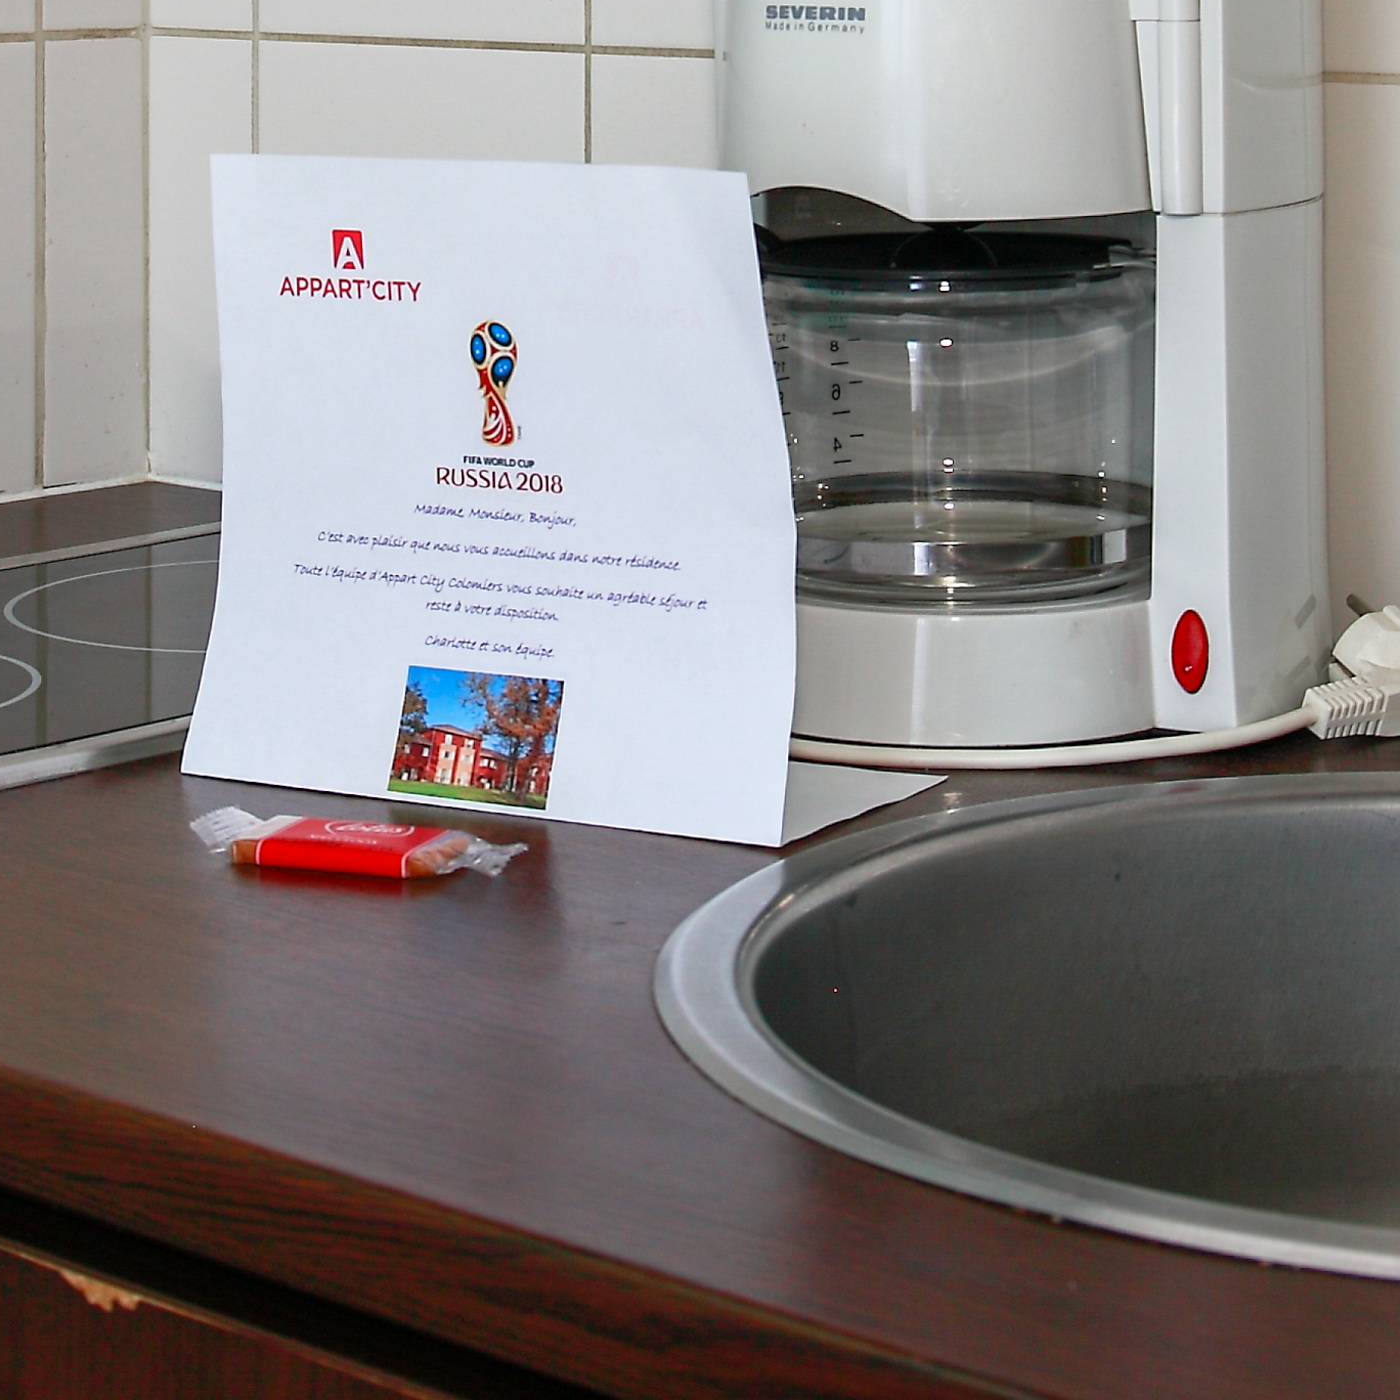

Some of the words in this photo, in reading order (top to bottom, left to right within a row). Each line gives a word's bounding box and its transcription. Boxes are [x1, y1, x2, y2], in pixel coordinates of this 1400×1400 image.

[765, 5, 866, 21] SEVERIN
[765, 22, 791, 31] Made
[794, 22, 804, 31] in
[808, 22, 865, 34] Germany
[336, 236, 364, 269] A
[280, 276, 421, 302] APPART'CITY
[463, 455, 482, 464] FIFA
[483, 457, 516, 467] WORLD
[517, 459, 535, 469] CUP
[436, 467, 513, 490] RUSSIA
[516, 472, 563, 494] 2018
[469, 508, 525, 524] Monsieur,
[529, 511, 577, 530] Bonjour,
[318, 531, 343, 543] C'est
[346, 534, 369, 545] avec
[371, 535, 408, 550] plaisir
[410, 541, 431, 553] que
[433, 543, 460, 553] nous
[464, 545, 489, 555] vous
[491, 546, 555, 561] accueillons
[559, 550, 588, 564] dans
[591, 555, 622, 567] notre
[294, 563, 323, 577] Toute
[325, 566, 367, 584] l'équipe
[369, 570, 417, 587] d'Appart
[420, 574, 445, 593] City
[448, 577, 503, 592] Colomiers
[506, 584, 532, 595] vous
[535, 585, 584, 600] souhaite
[586, 592, 603, 601] un
[607, 590, 656, 606] agréable
[659, 593, 694, 612] séjour
[697, 599, 708, 610] et
[425, 601, 452, 612] reste
[454, 600, 462, 612] à
[464, 605, 492, 616] votre
[424, 635, 476, 651] Charlotte
[479, 641, 490, 651] et
[492, 642, 512, 653] son
